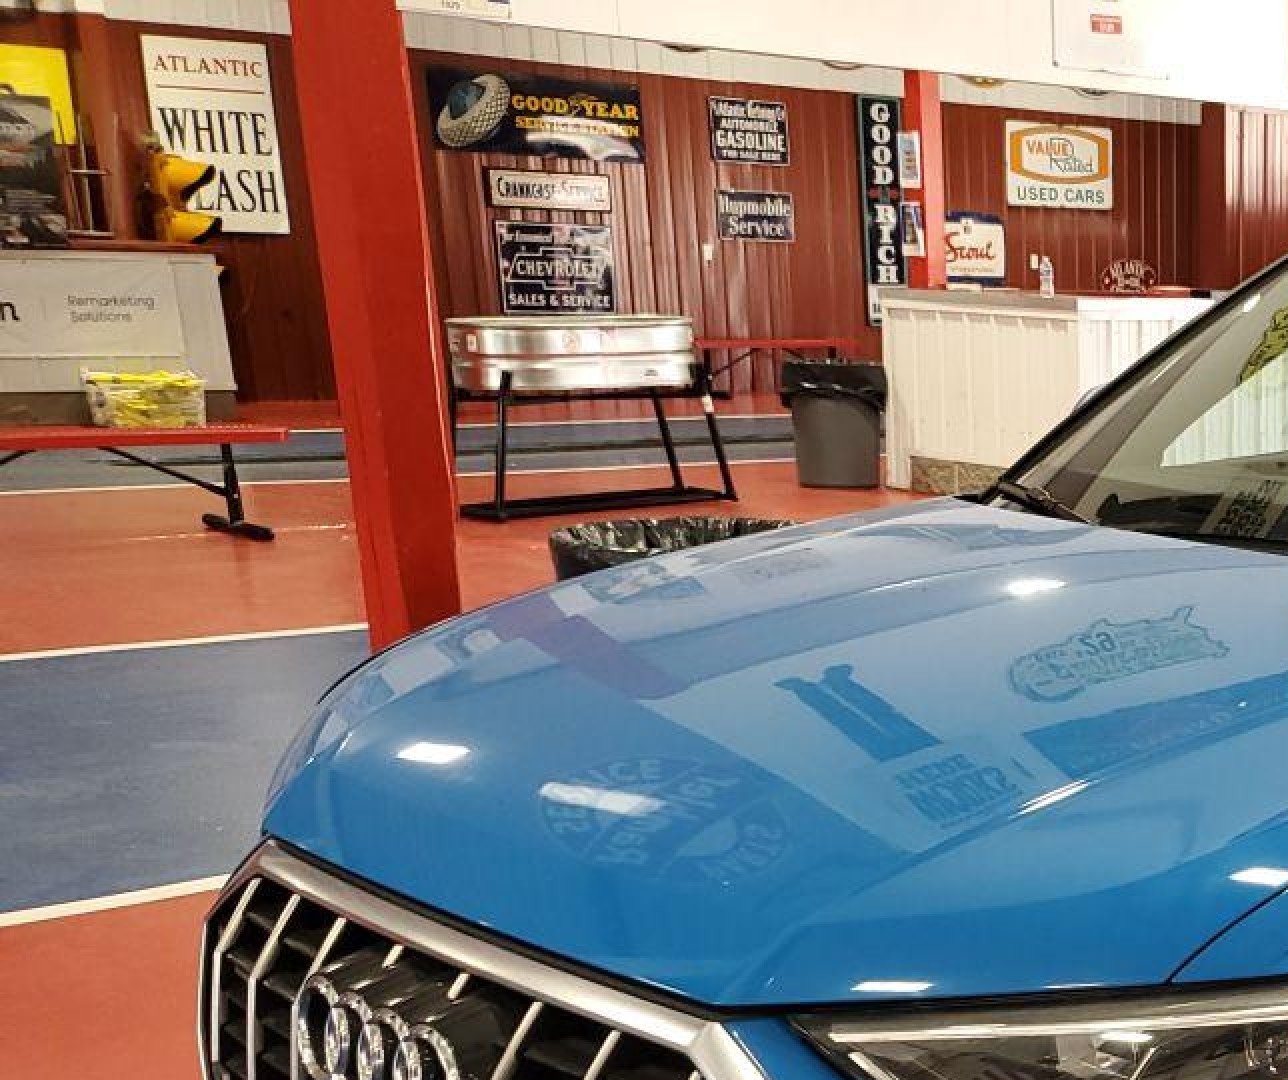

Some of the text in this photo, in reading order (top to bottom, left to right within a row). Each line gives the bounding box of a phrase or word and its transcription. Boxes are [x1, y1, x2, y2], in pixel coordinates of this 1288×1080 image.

[153, 54, 262, 78] ATLANTIC
[157, 107, 273, 157] WHITE
[715, 130, 786, 152] GASOLINE
[1026, 140, 1070, 157] VALUE
[194, 170, 281, 213] LASH
[1017, 185, 1105, 205] USED CARS
[730, 215, 785, 237] Service
[517, 257, 602, 278] CHEVROLET
[67, 294, 155, 311] Remarketing
[508, 292, 611, 308] SALES & SERVICE
[70, 310, 132, 323] Solutions
